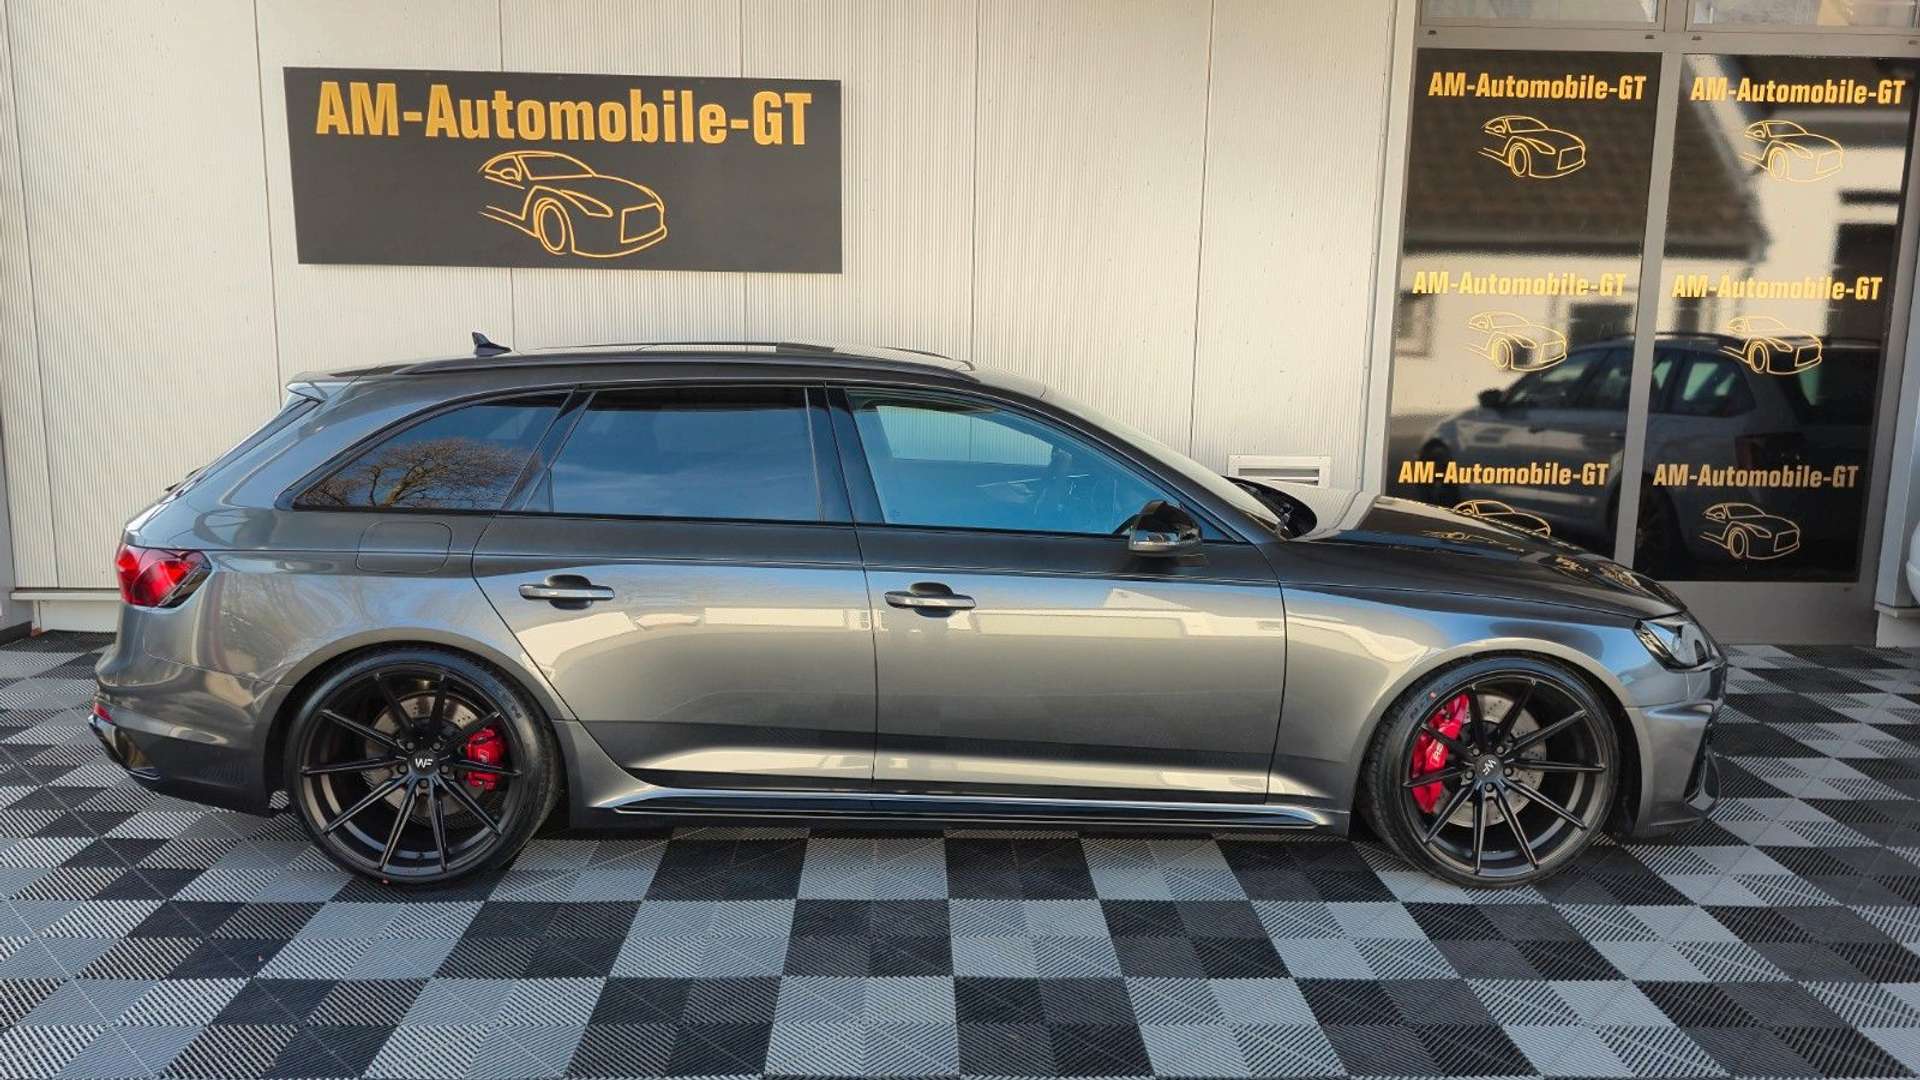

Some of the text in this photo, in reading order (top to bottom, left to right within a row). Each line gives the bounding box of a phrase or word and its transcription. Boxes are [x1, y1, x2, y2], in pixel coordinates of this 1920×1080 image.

[1428, 72, 1647, 100] AM-Automobile-GT
[1690, 77, 1906, 104] AM-Automobile-GT
[316, 80, 812, 145] AM-Automobile-GT
[1412, 271, 1626, 297] AM-Automobile-GT
[1672, 275, 1883, 301] AM-Automobile-GT
[1398, 461, 1609, 486] AM-Automobile-GT
[1652, 464, 1858, 489] AM-Automobile-GT
